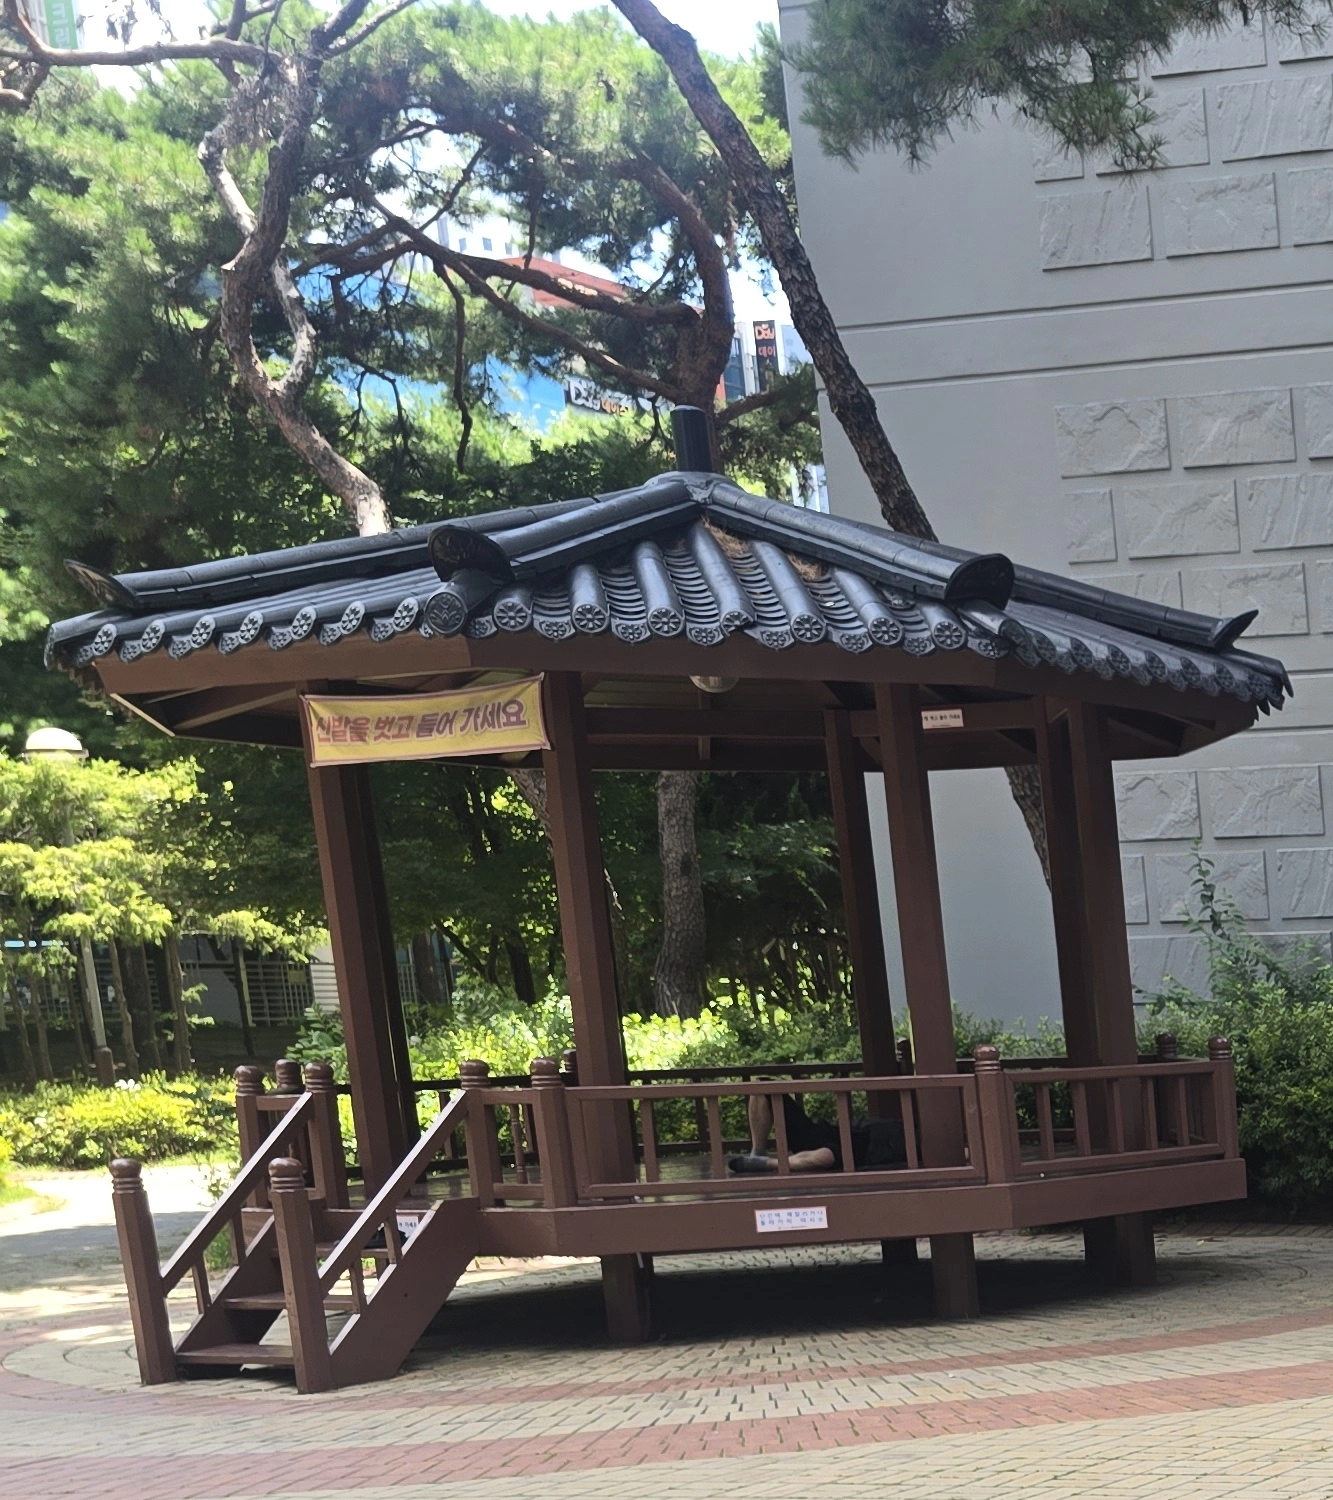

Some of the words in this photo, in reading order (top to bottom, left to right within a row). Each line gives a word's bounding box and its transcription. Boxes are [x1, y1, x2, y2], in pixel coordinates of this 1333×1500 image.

[316, 715, 371, 743] 신발을
[374, 715, 414, 741] 벗고
[416, 710, 458, 739] 들어
[460, 699, 527, 732] 가세요
